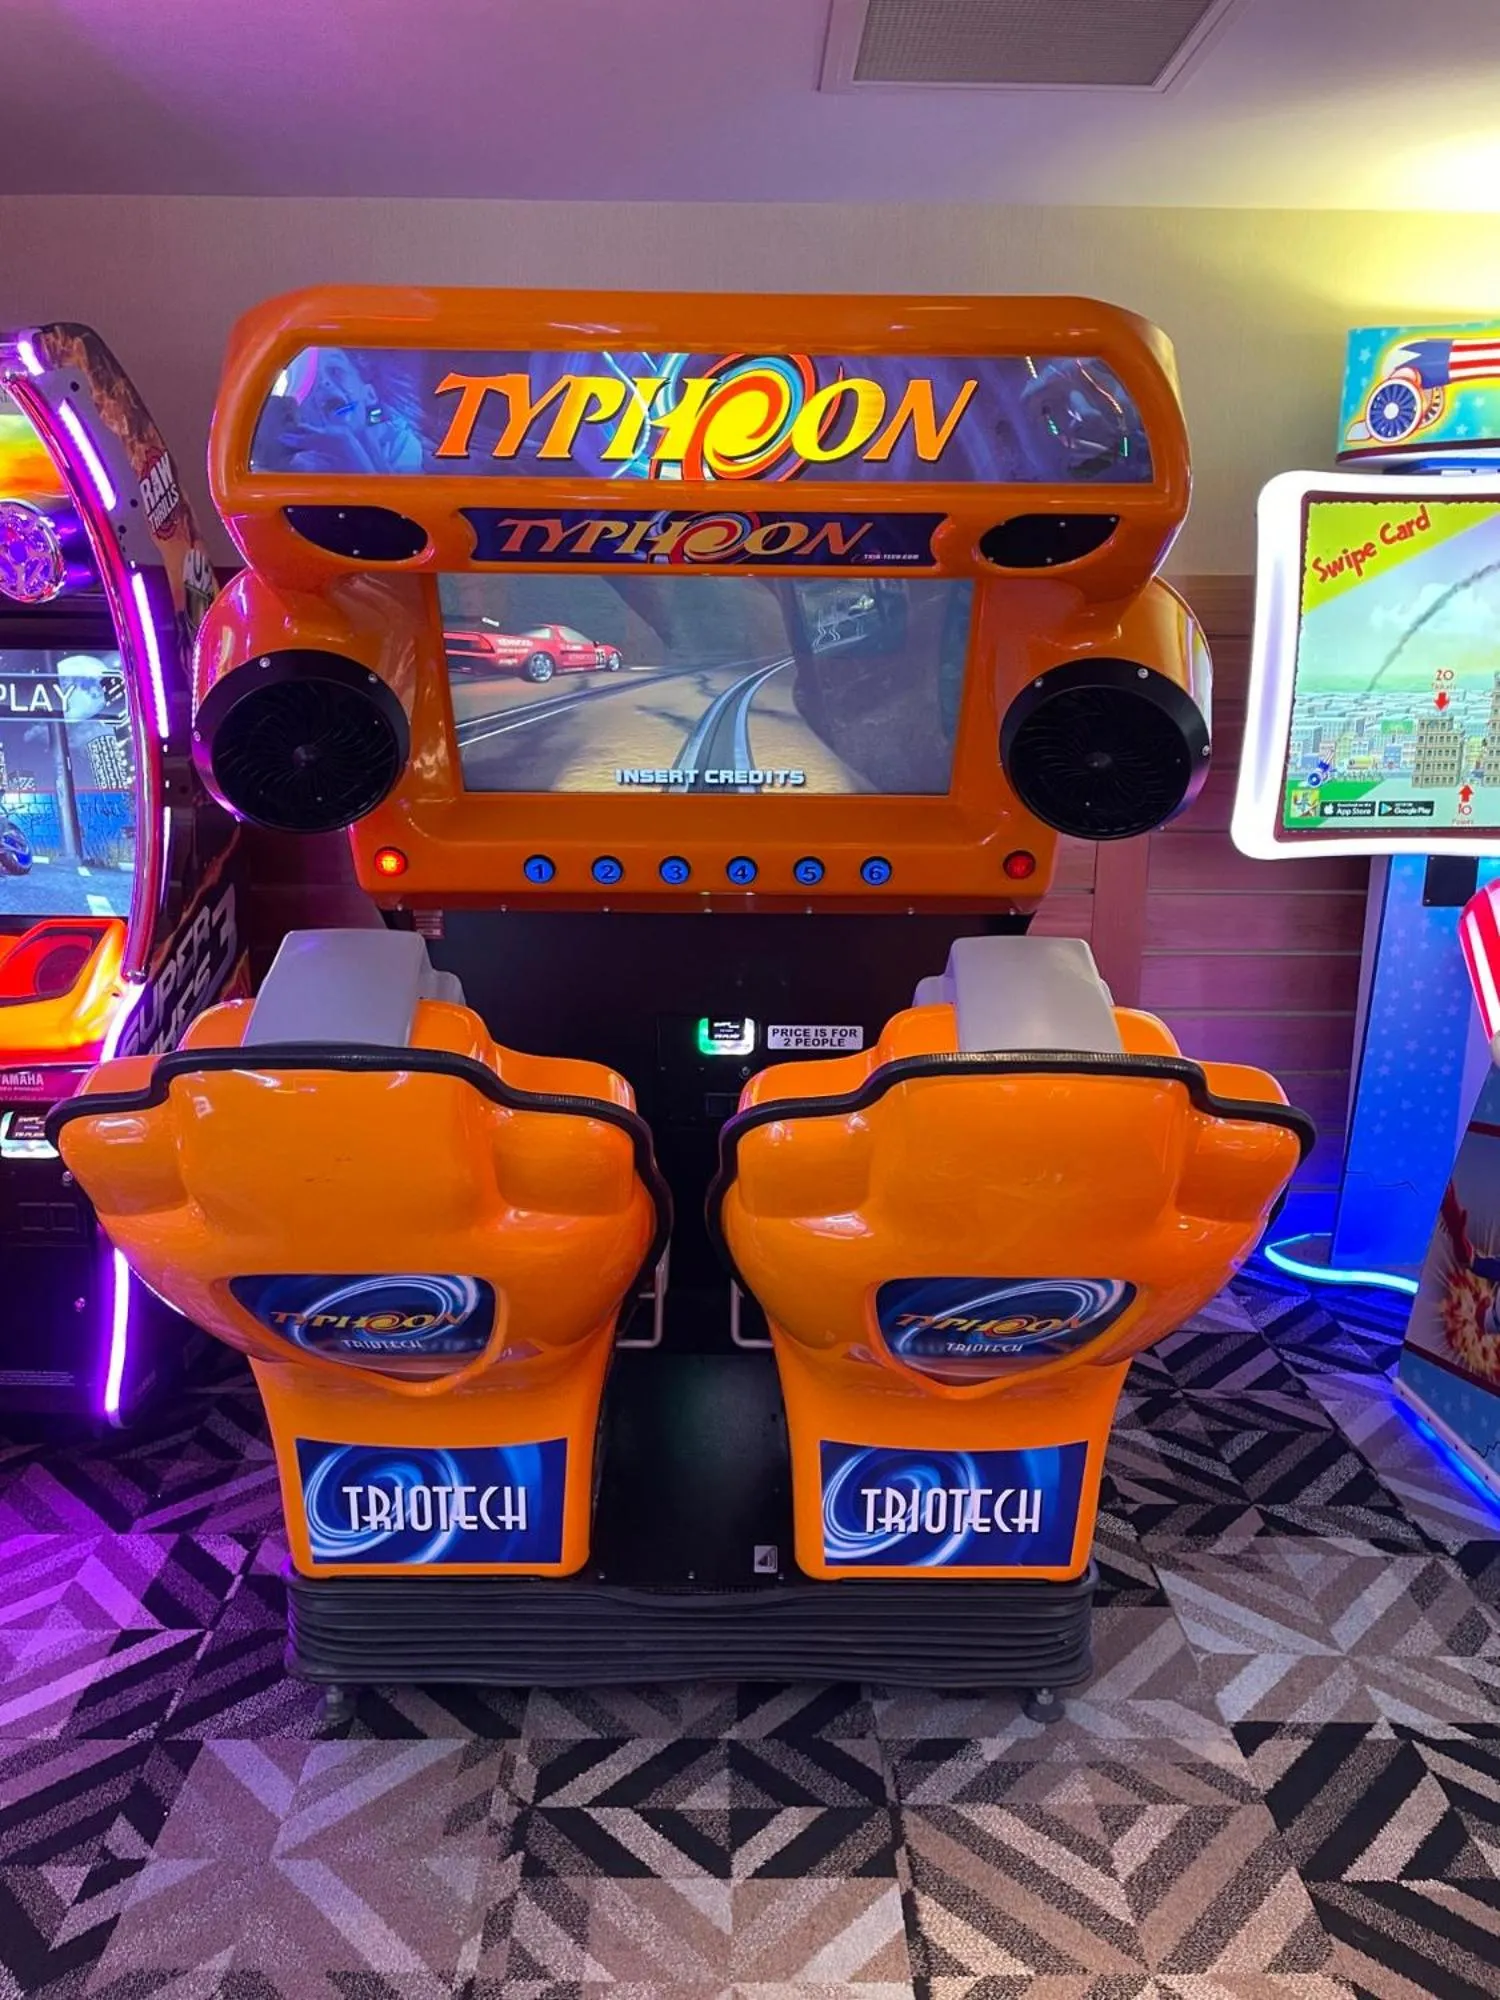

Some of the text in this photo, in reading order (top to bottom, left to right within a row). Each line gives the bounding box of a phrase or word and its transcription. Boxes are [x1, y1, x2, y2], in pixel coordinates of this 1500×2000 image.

[434, 364, 978, 480] TYPHOON
[139, 451, 173, 514] RAW
[148, 483, 180, 534] THRILLS
[497, 514, 874, 562] TYPHOON
[1312, 504, 1431, 583] Swipe Card
[1435, 669, 1454, 681] 20
[615, 768, 805, 786] INSERT CREDITS
[1336, 808, 1371, 817] App Store
[1394, 807, 1431, 816] Google Play
[1458, 803, 1472, 815] 10
[534, 864, 883, 881] 1 2 3 4 5 6
[772, 1028, 857, 1037] PRICE IS FOR
[784, 1038, 845, 1047] 2 PEOPLE
[0, 1072, 44, 1086] AMAHA
[271, 1311, 470, 1332] TYPHOON
[896, 1313, 1081, 1336] TYPHOON
[342, 1338, 422, 1350] TRIOTECH
[946, 1342, 1024, 1353] TRIOTECH
[341, 1485, 528, 1531] TRIOTECH
[861, 1486, 1042, 1533] TRIOTECH
